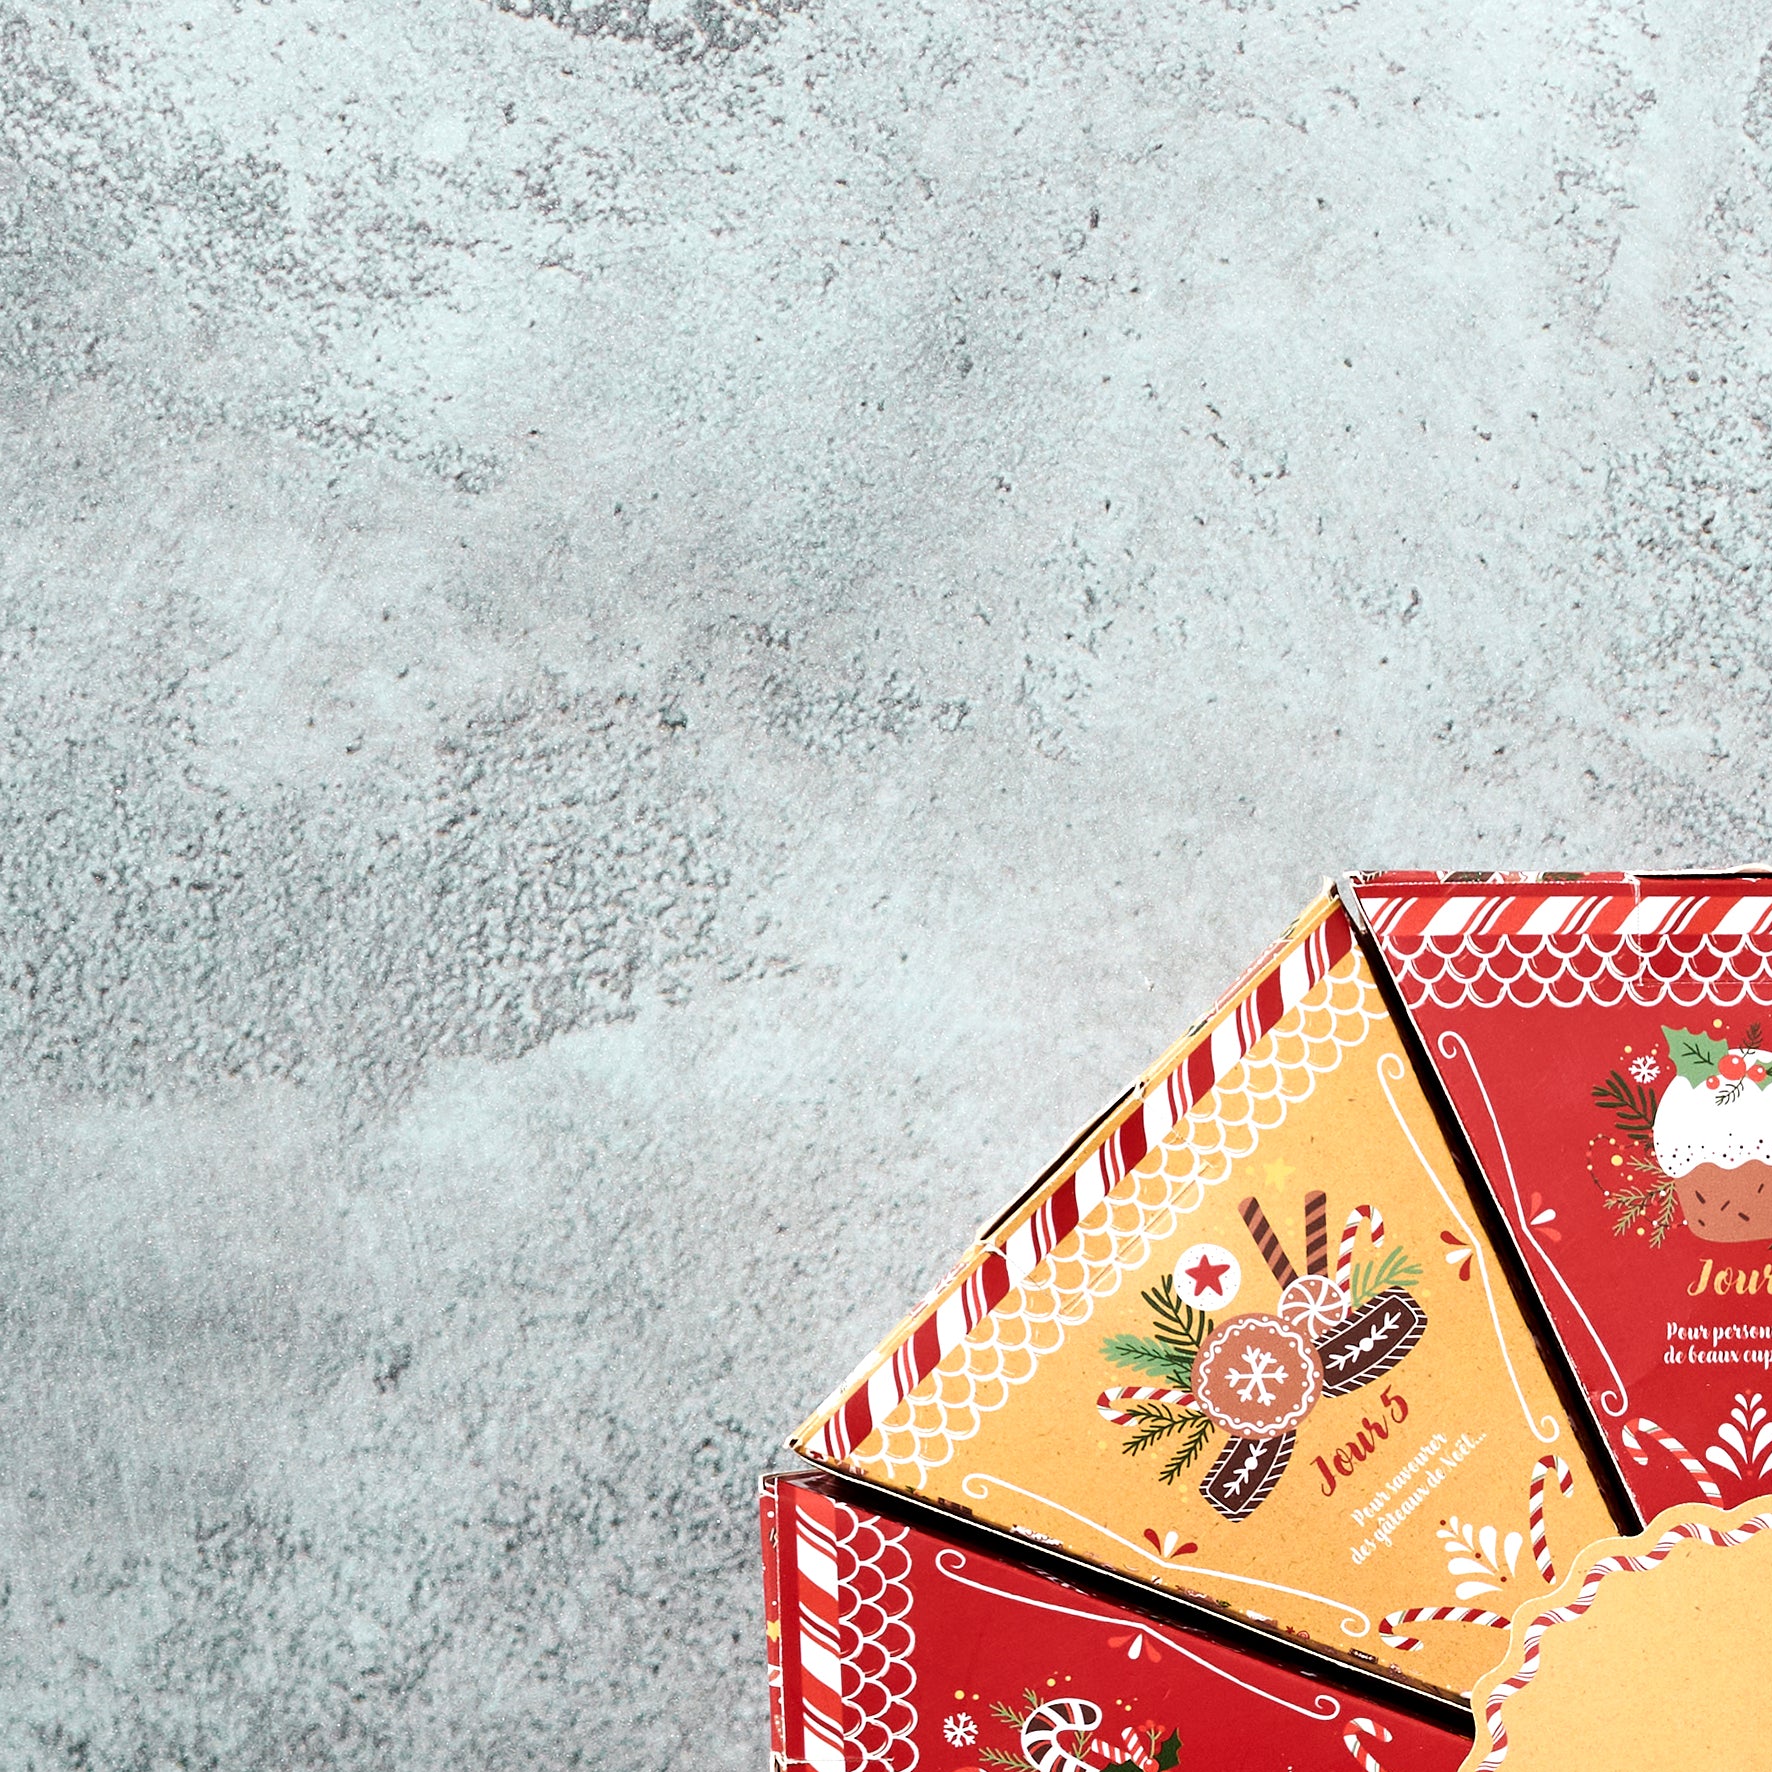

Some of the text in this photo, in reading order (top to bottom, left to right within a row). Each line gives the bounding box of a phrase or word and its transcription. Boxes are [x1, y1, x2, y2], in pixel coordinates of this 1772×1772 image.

[1664, 1345, 1685, 1364] de
[1688, 1345, 1740, 1364] beaux
[1666, 1321, 1710, 1340] Pour
[1310, 1384, 1408, 1496] Jour 5
[1350, 1433, 1447, 1527] Pour savourer
[1350, 1433, 1487, 1564] des gâteaux de Noël...
